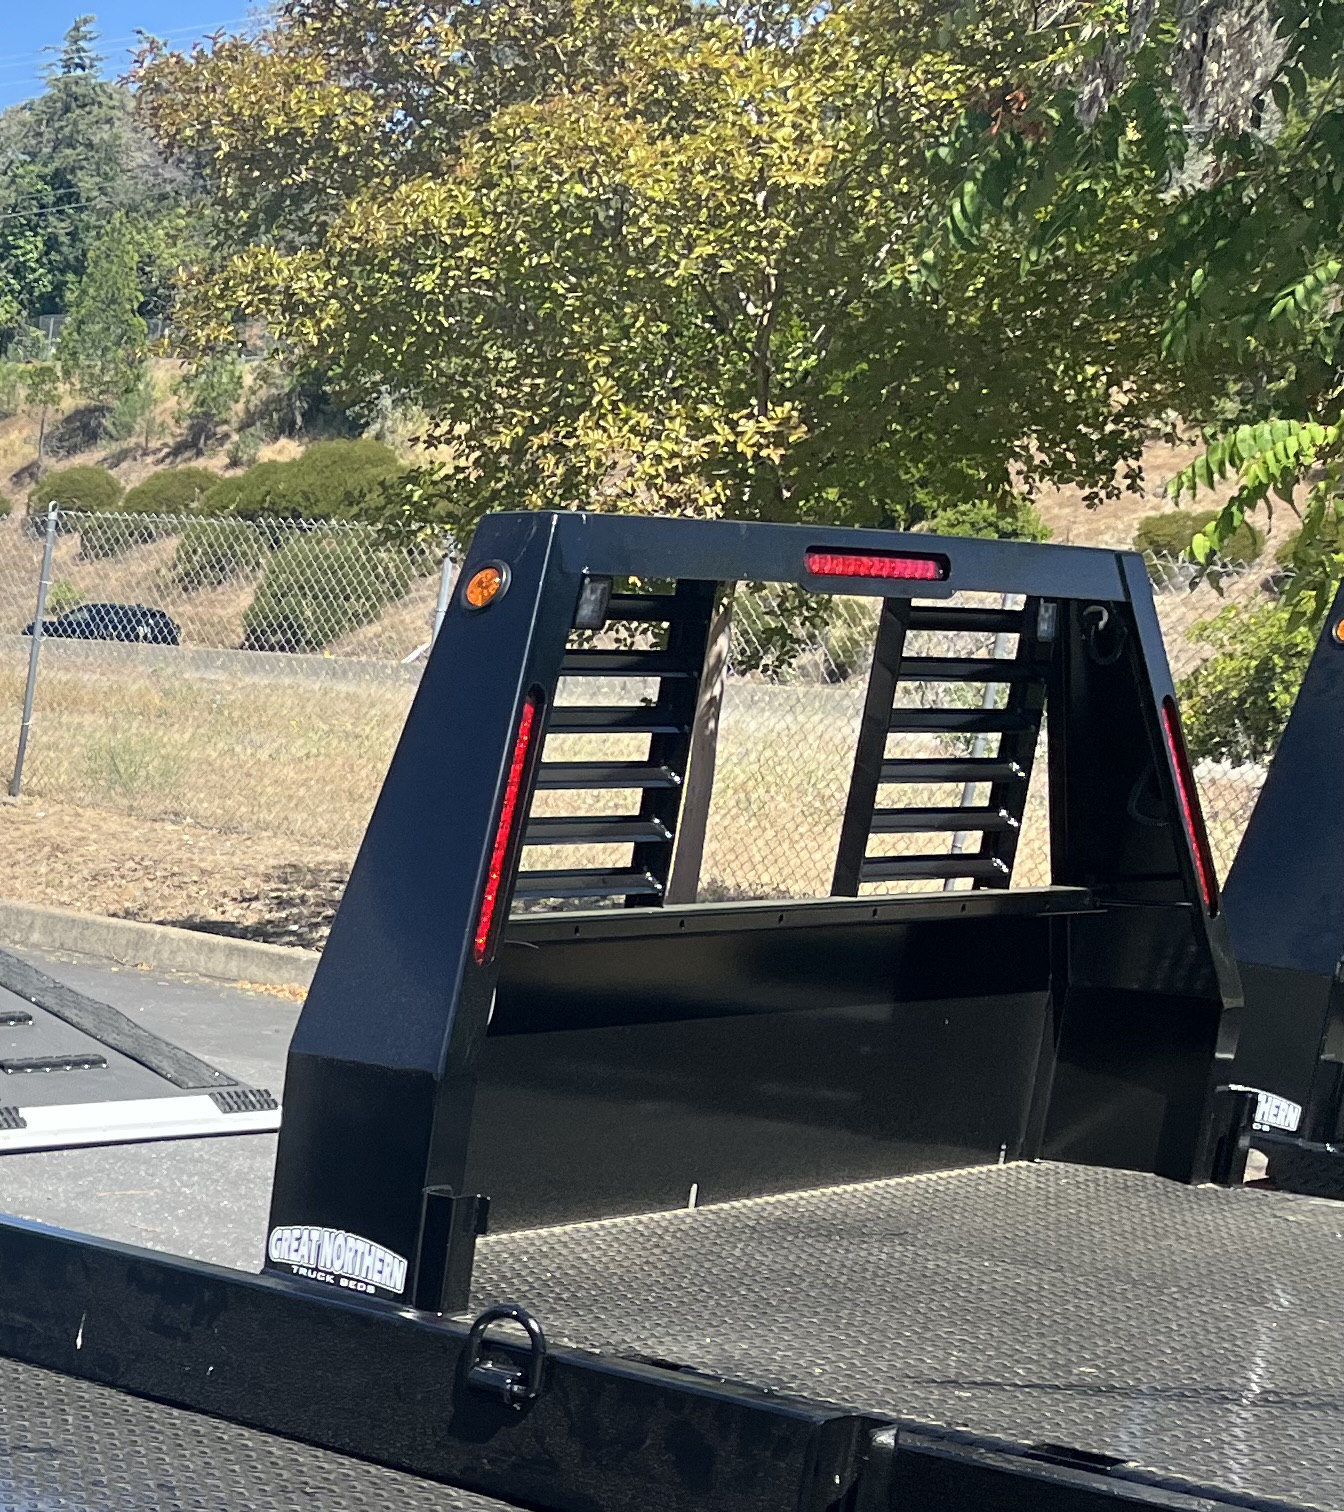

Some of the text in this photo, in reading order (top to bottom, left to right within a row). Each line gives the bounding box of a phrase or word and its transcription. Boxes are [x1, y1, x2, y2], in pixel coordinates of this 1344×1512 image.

[1255, 1092, 1300, 1130] HERN
[272, 1228, 405, 1292] GREAT NORTHERN
[291, 1264, 376, 1295] TRUCK BEDS
